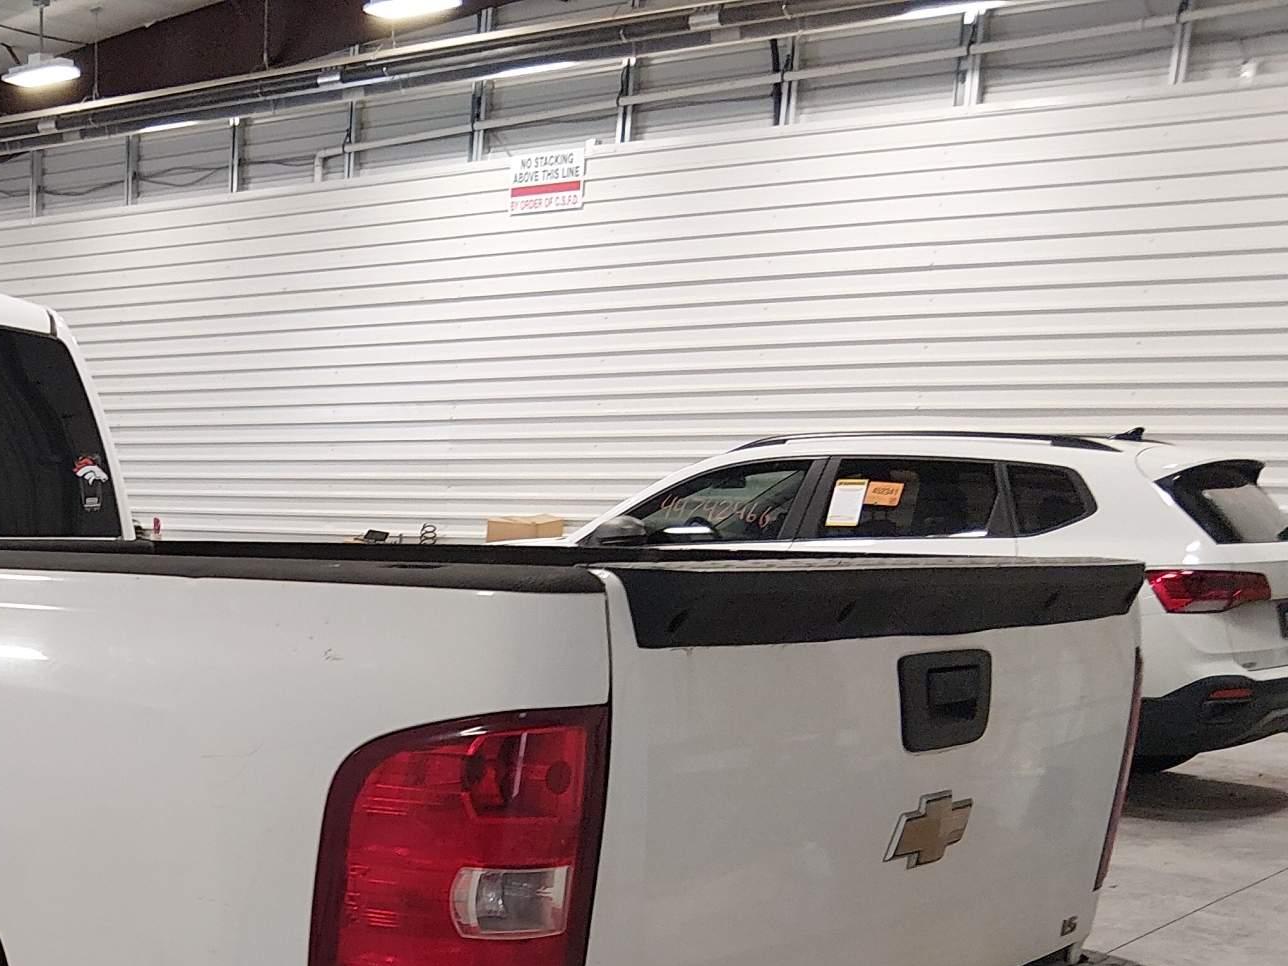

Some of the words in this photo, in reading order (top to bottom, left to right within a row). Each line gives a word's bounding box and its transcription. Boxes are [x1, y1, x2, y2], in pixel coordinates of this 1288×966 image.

[520, 157, 532, 169] NO
[534, 152, 574, 168] STACKING
[513, 170, 539, 184] ABOVE
[541, 167, 560, 181] THIS
[561, 165, 581, 178] LINE
[520, 198, 543, 211] ORDER
[544, 196, 554, 208] OF
